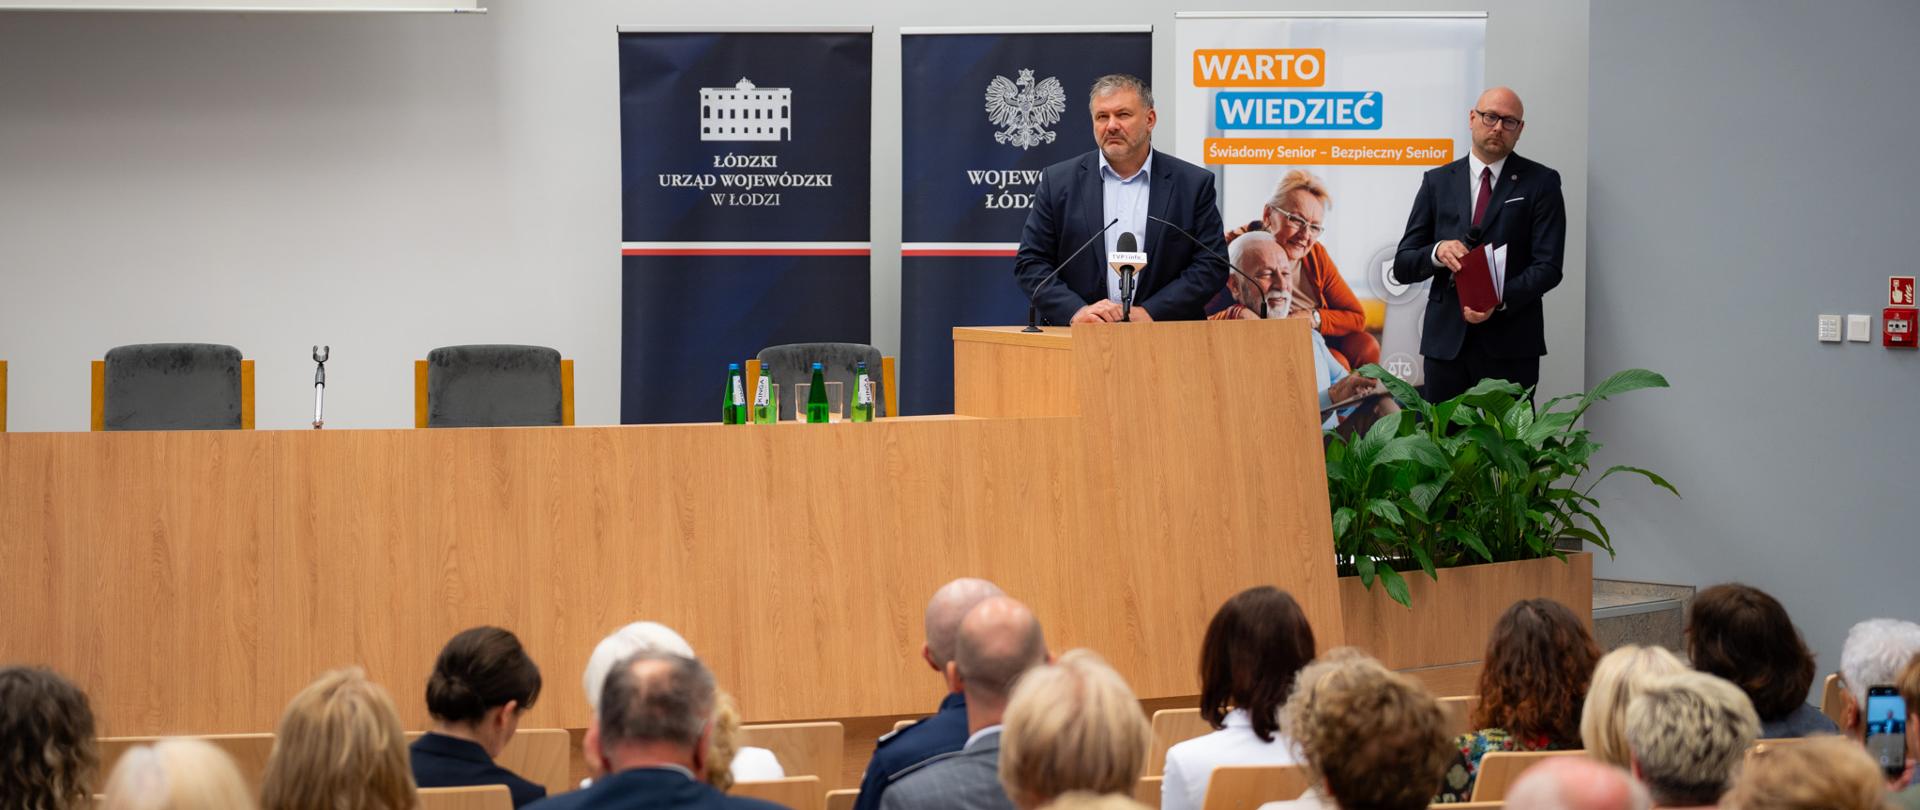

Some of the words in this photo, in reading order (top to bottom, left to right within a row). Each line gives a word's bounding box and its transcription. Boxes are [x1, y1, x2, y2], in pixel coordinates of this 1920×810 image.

[1198, 54, 1320, 80] WARTO
[1220, 92, 1375, 125] WIEDZIEĆ
[713, 153, 778, 168] ŁÓDZKI
[1209, 143, 1274, 160] Świadomy
[1277, 146, 1316, 158] Senior
[1331, 146, 1403, 161] Bezpieczny
[1406, 146, 1448, 159] Senior
[658, 174, 717, 190] URZĄD
[719, 172, 833, 190] WOJEWÓDZKI
[967, 170, 1043, 189] WOJEW
[711, 193, 726, 206] W
[729, 193, 781, 206] ŁODZI
